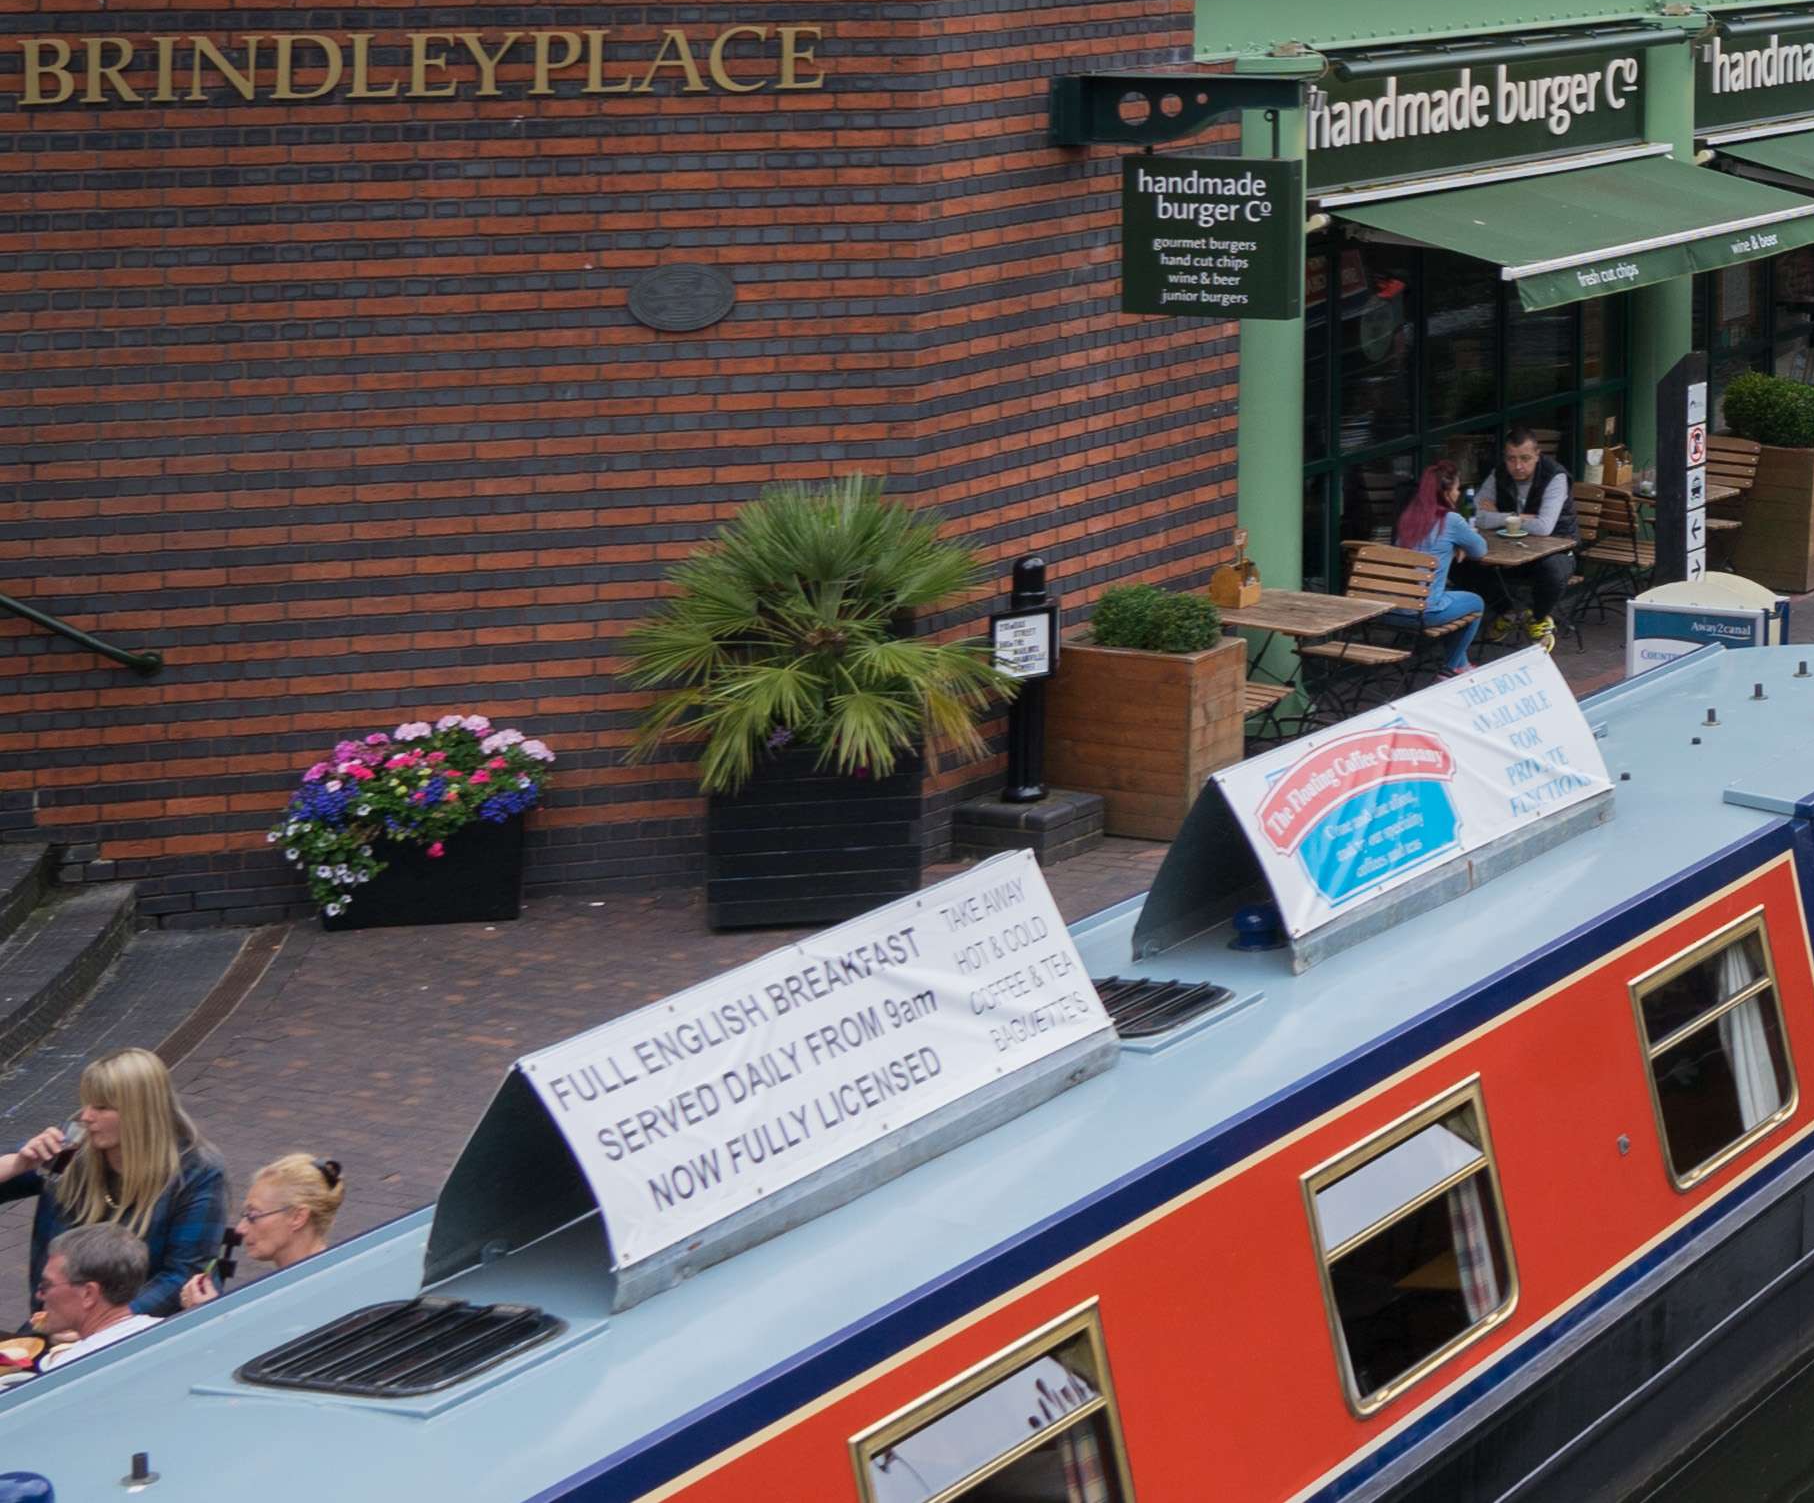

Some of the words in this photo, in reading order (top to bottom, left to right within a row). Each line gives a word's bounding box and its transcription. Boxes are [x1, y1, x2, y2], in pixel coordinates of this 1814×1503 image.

[17, 25, 826, 106] BRINDLEYPLACE
[1308, 67, 1490, 150] handmade
[1497, 63, 1601, 136] burger
[1138, 169, 1267, 197] handmade
[1157, 195, 1241, 228] burger
[1153, 238, 1206, 251] gourmet
[1209, 237, 1257, 253] burgers
[1160, 253, 1191, 266] hand
[1193, 255, 1214, 267] cut
[1215, 255, 1249, 271] chips
[1730, 238, 1751, 255] wine
[1759, 232, 1778, 248] beer
[1167, 271, 1199, 284] wine
[1200, 272, 1211, 285] &
[1213, 273, 1241, 286] beer
[1576, 267, 1601, 287] fresh
[1600, 267, 1617, 283] cut
[1616, 262, 1639, 281] chips
[1160, 289, 1198, 304] junior
[1201, 290, 1249, 306] burgers
[1690, 620, 1751, 637] Away2canal
[1457, 683, 1494, 708] THIS
[1491, 665, 1535, 696] BOAT
[1472, 689, 1552, 733] AVAILABLE
[1509, 726, 1543, 749] FOR
[1266, 806, 1295, 837] The
[1285, 765, 1342, 813] Floating
[1333, 750, 1378, 776] Coffee
[1376, 744, 1445, 767] Company
[940, 897, 984, 932] TAKE
[982, 877, 1026, 915] AWAY
[953, 941, 990, 975] HOT
[989, 935, 1006, 959] &
[1003, 915, 1049, 952] COLD
[970, 970, 1031, 1015] COFFEE
[1028, 965, 1045, 988] &
[1040, 950, 1077, 980] TEA
[549, 1056, 638, 1112] FULL
[635, 994, 769, 1075] ENGLISH
[767, 926, 925, 1017] BREAKFAST
[597, 1083, 722, 1162] SERVED
[722, 1041, 804, 1104] DAILY
[807, 1014, 884, 1070] FROM
[884, 988, 938, 1030] 9am
[648, 1153, 724, 1213] NOW
[726, 1104, 813, 1175] FULLY
[817, 1044, 942, 1132] LICENSED
